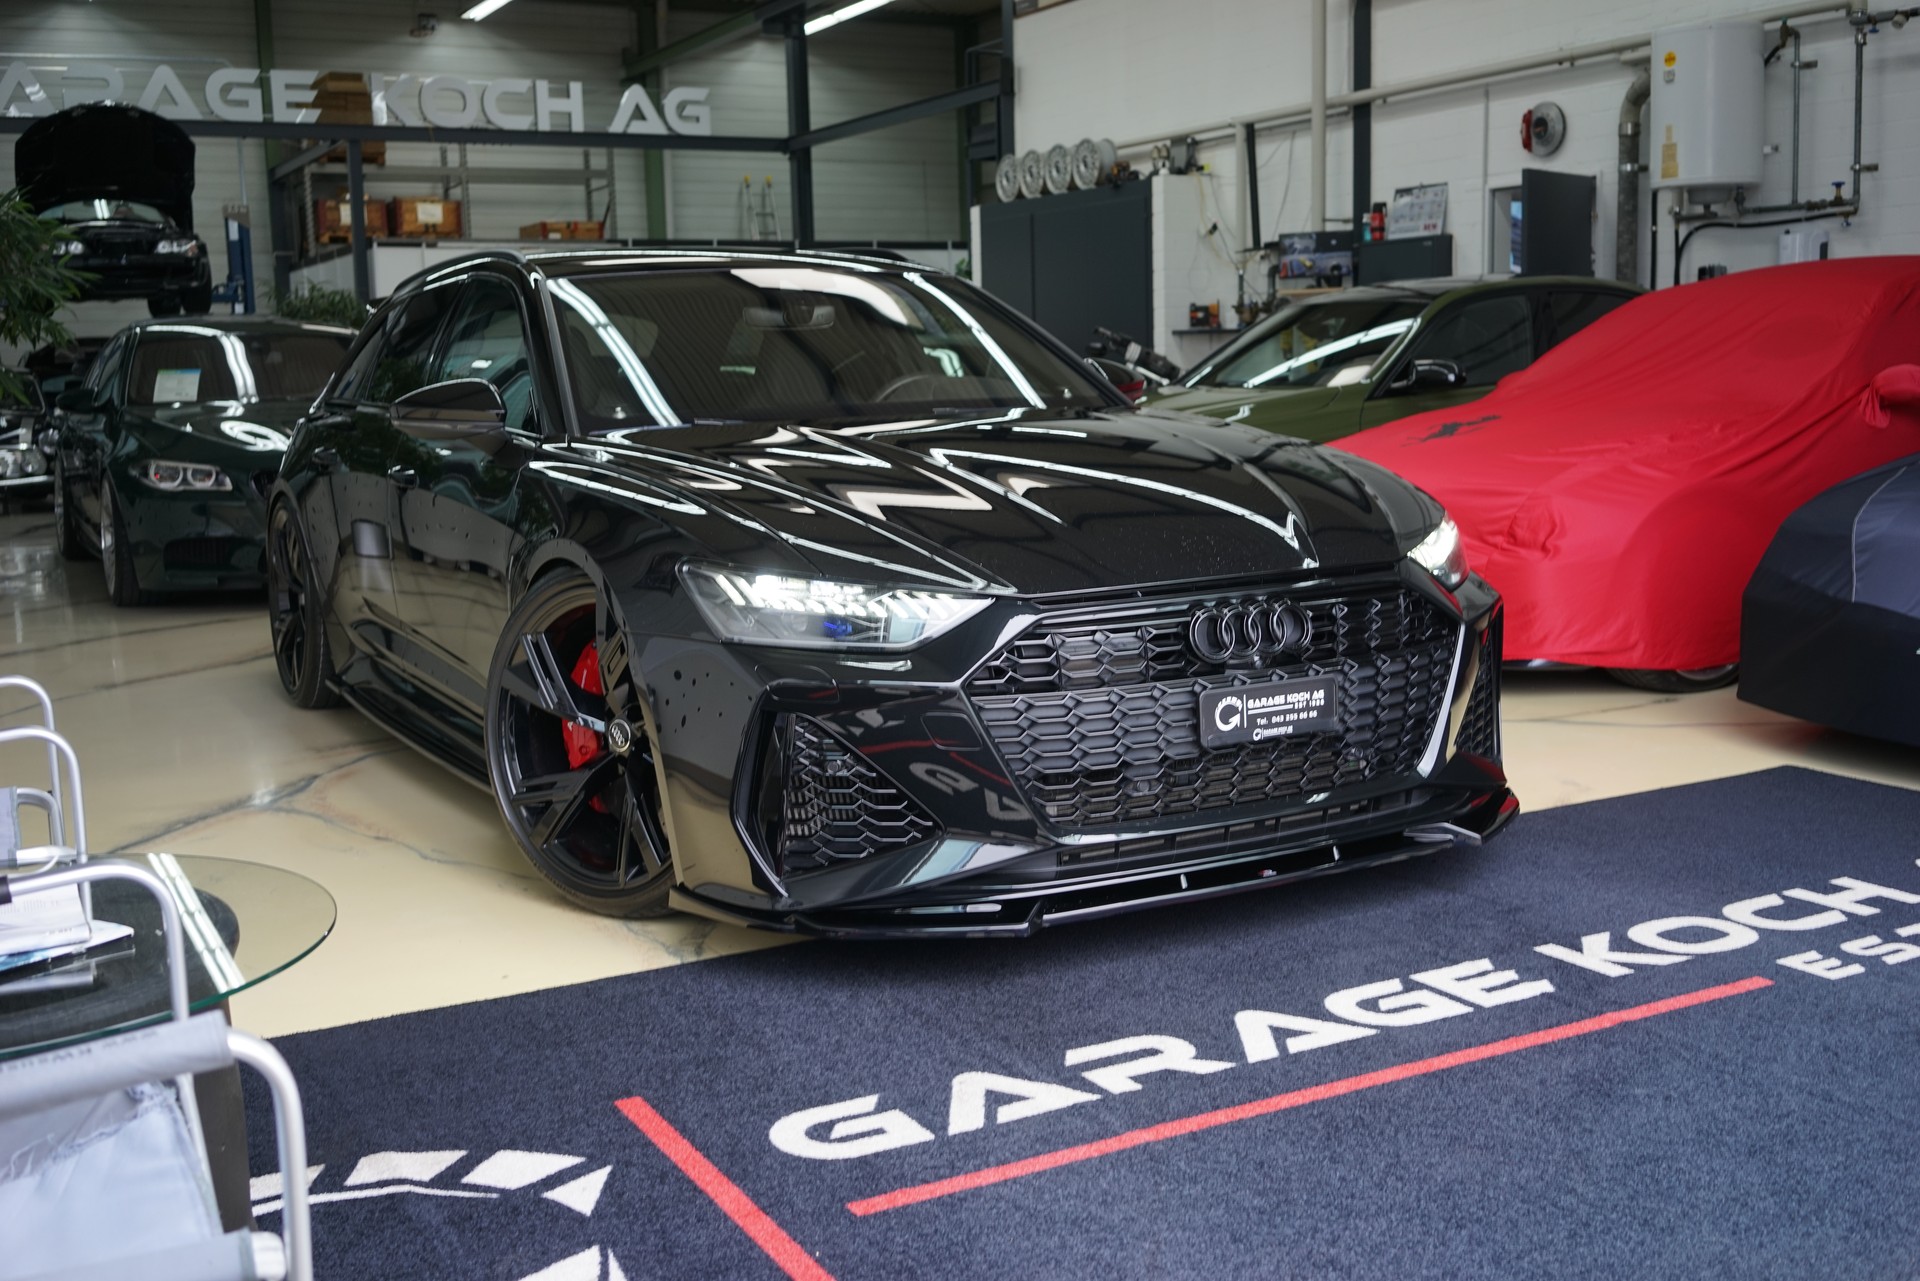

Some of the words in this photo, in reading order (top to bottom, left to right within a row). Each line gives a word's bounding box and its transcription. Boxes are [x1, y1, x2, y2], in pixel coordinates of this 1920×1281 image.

[371, 74, 584, 132] KOCH
[608, 84, 711, 136] AG
[1247, 694, 1286, 709] GARAGE
[1286, 691, 1311, 704] KOCH
[1311, 689, 1325, 700] AG
[769, 958, 1554, 1160] GARAGE
[1533, 876, 1920, 977] KOCH
